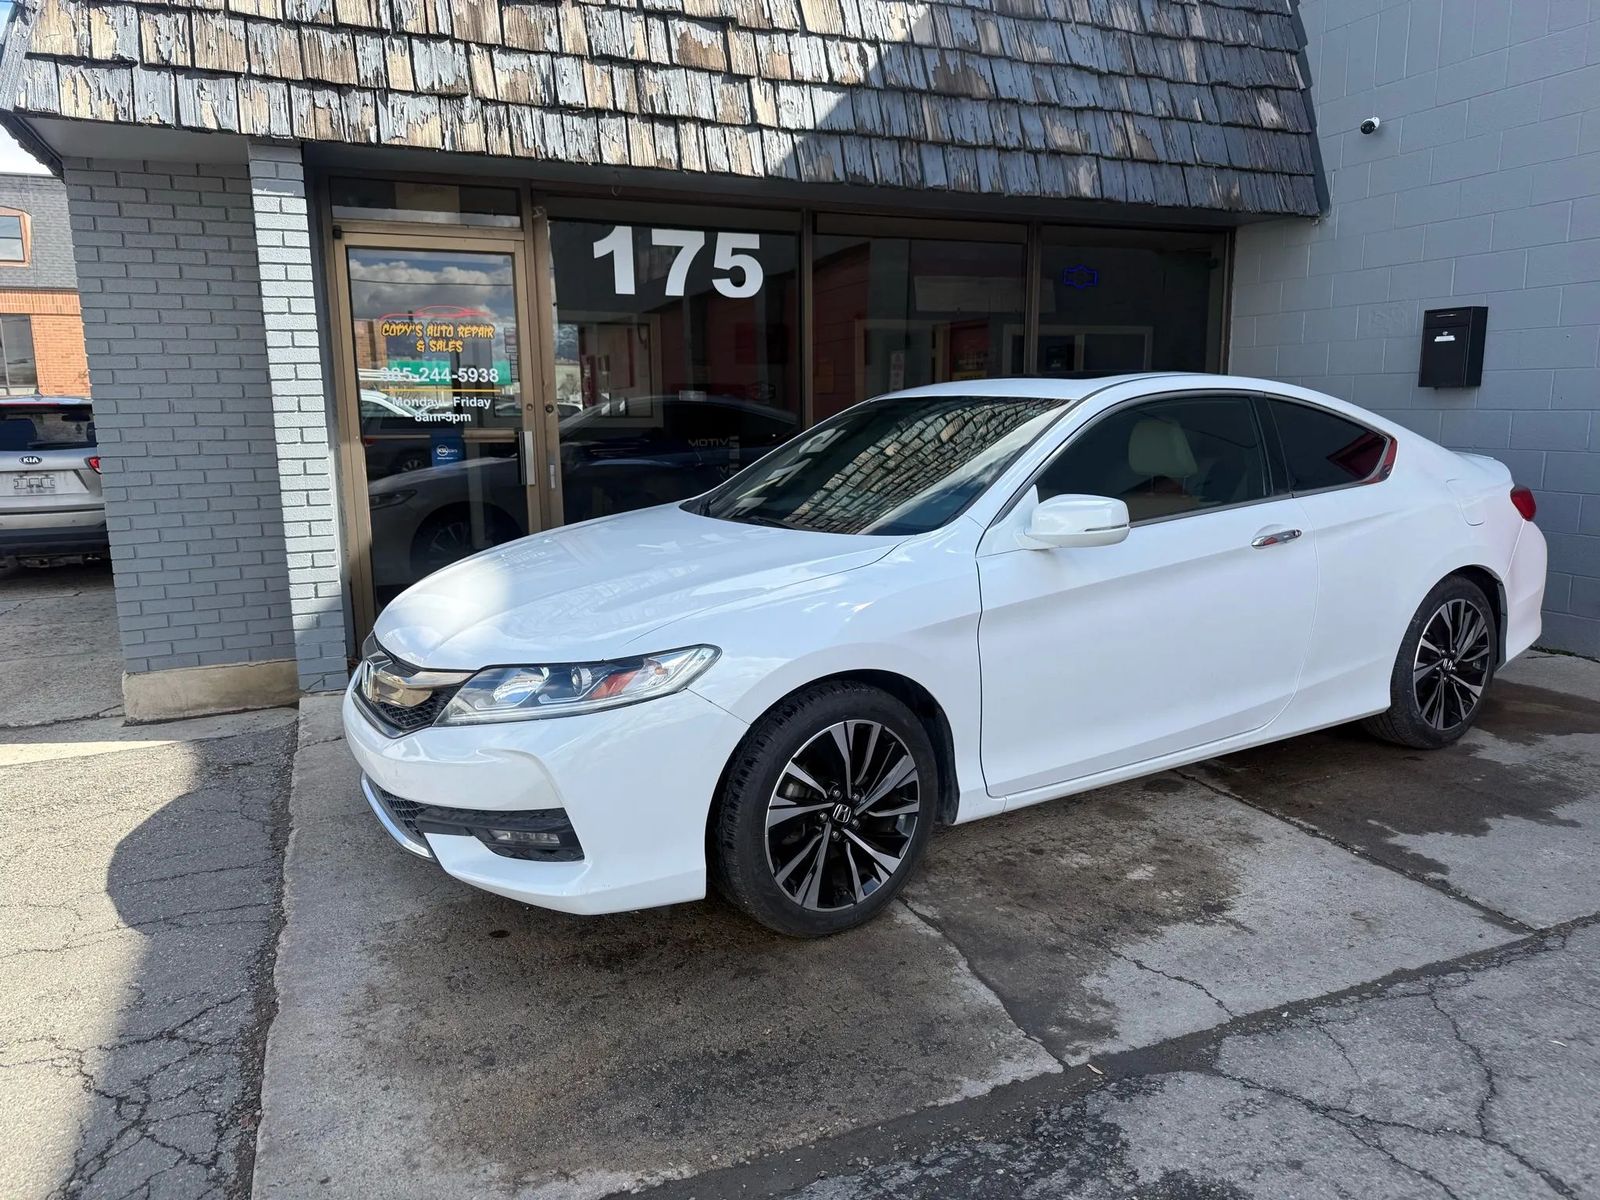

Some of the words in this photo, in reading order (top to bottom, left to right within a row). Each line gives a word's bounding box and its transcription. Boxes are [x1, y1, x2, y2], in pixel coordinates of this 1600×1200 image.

[593, 225, 764, 298] 175
[381, 321, 423, 337] CODY'S
[427, 323, 454, 337] AUTO
[457, 323, 495, 338] REPAIR
[416, 340, 425, 352] &
[429, 339, 463, 353] SALES
